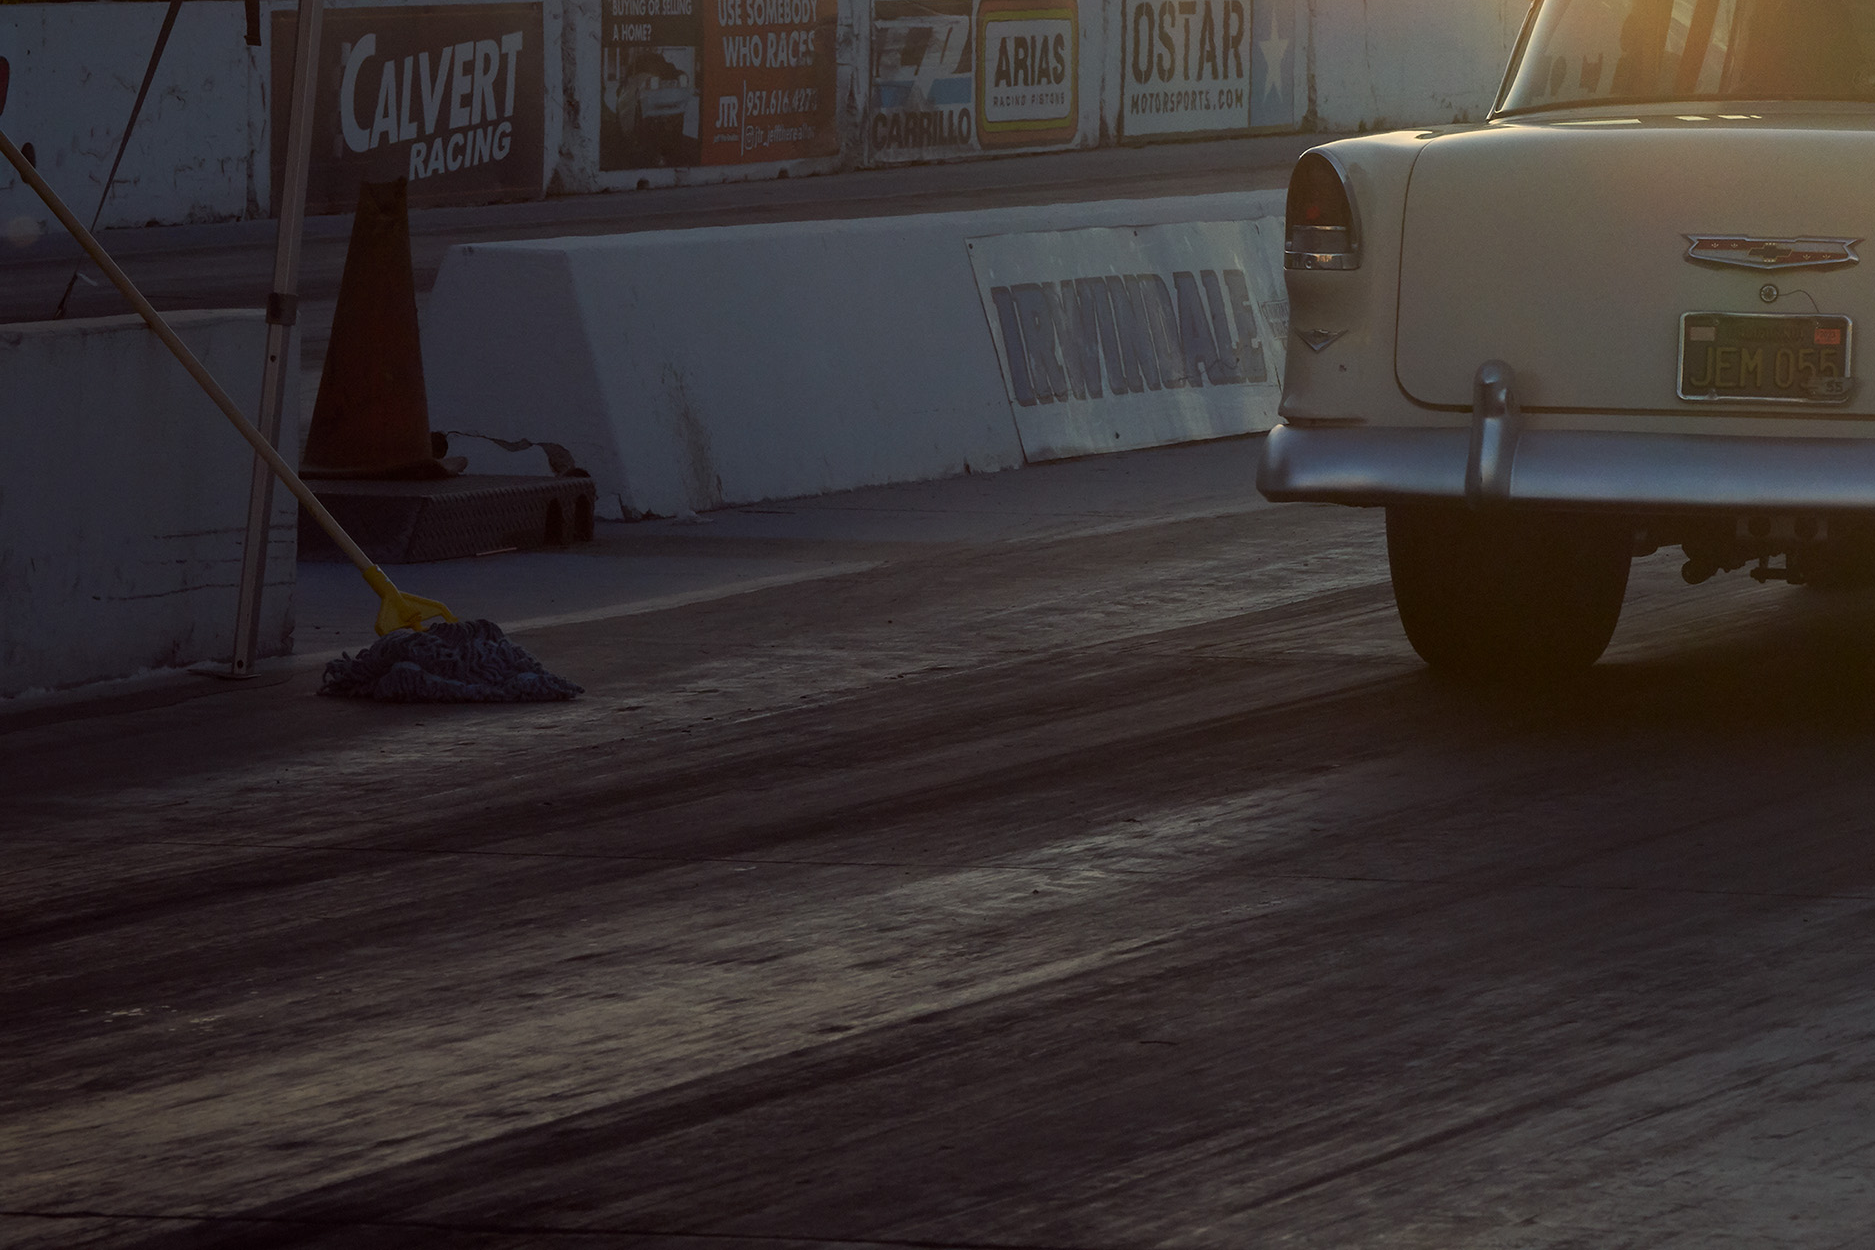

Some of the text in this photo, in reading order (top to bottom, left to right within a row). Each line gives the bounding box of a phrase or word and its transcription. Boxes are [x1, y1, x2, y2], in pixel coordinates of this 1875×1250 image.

[613, 23, 652, 41] A HOME?
[722, 30, 816, 69] WHO RACES
[1132, 0, 1246, 86] OSTAR
[994, 32, 1066, 88] ARIAS
[341, 31, 523, 153] CALVERT
[715, 95, 739, 129] JTR
[992, 91, 1066, 108] RACING PISTONS
[1130, 87, 1244, 115] MOTORSPORTS.COM
[872, 108, 972, 150] CARRILLO
[408, 121, 512, 182] RACING
[990, 268, 1268, 408] IRWINDALE
[1690, 347, 1764, 389] JEM
